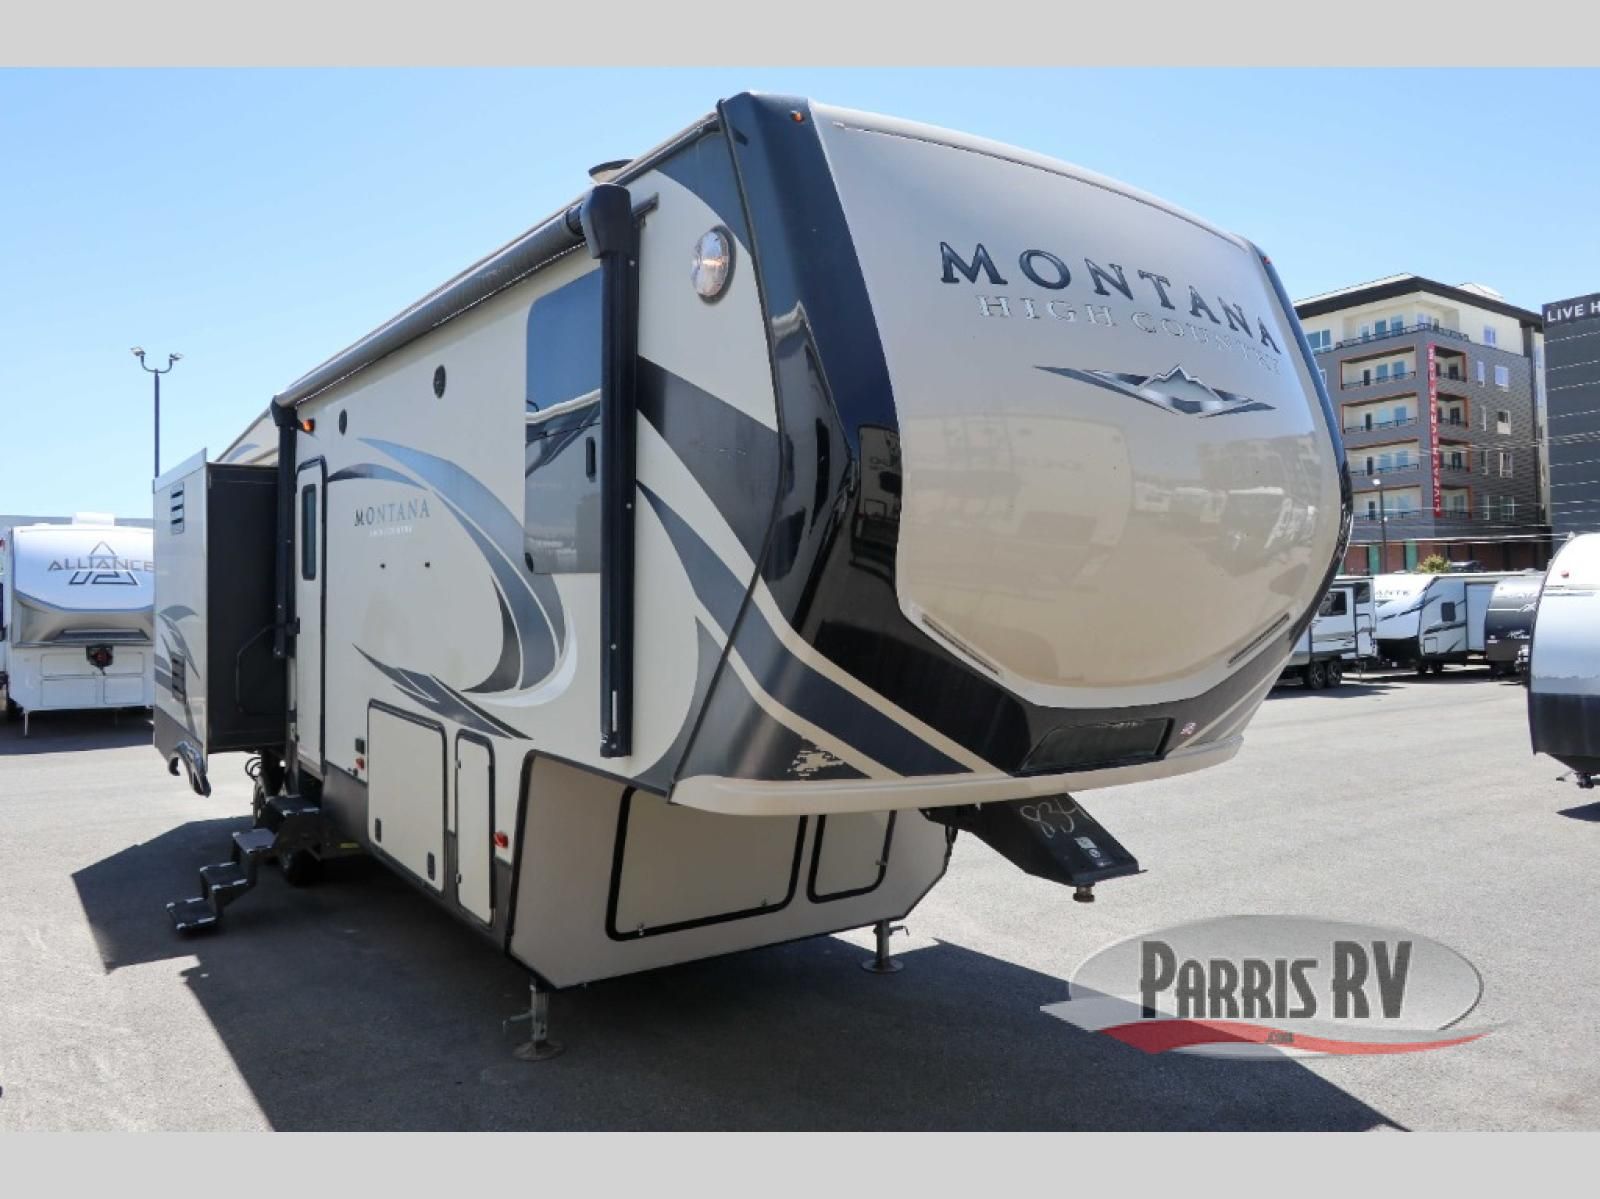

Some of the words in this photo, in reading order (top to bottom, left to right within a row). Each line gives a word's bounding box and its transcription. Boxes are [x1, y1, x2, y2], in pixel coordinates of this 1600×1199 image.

[939, 241, 1281, 354] MONTANA
[977, 296, 1117, 327] HIGH
[1546, 304, 1584, 322] LIVE
[354, 498, 430, 526] MONTANA
[48, 557, 153, 572] ALLIANCE
